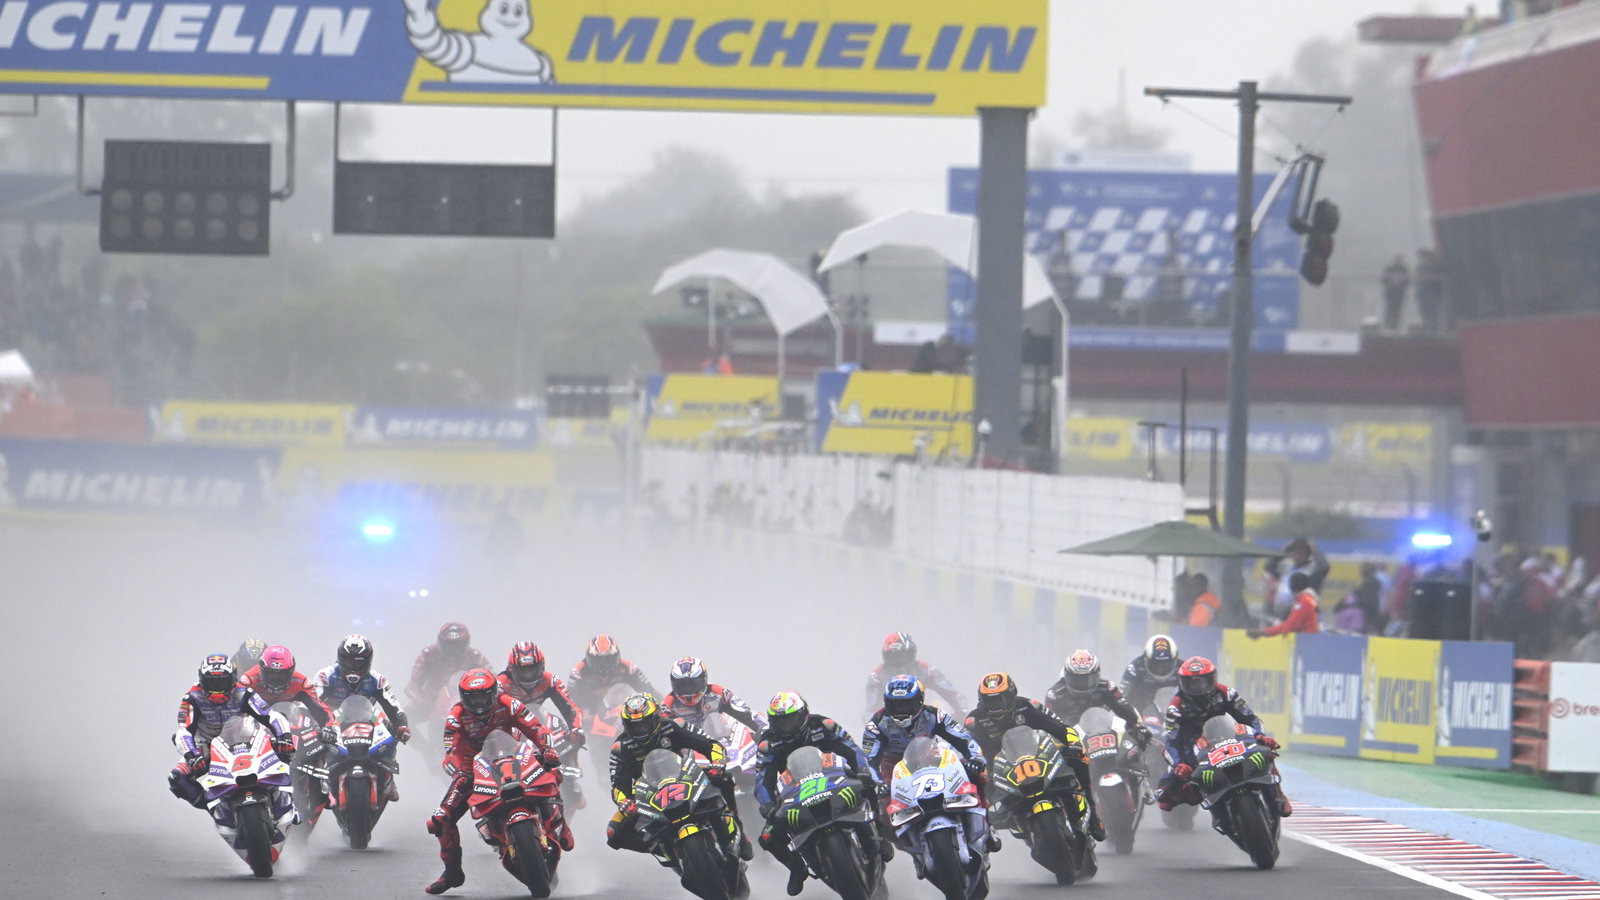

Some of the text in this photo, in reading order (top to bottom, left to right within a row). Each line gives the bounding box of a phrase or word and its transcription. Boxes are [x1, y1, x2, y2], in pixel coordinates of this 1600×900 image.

[566, 16, 1037, 73] MICHELIN
[195, 414, 335, 435] MICHELIN
[385, 418, 528, 439] MICHELIN
[24, 469, 245, 509] MICHELIN
[1304, 671, 1360, 720] MICHELIN
[1377, 676, 1433, 726] MICHELIN
[1451, 681, 1511, 730] MICHELIN
[341, 723, 373, 738] 42
[1087, 734, 1115, 753] 30
[1089, 748, 1118, 759] CUSTOM
[1214, 739, 1238, 749] ENEOS
[231, 755, 254, 772] 5
[260, 754, 279, 769] prima
[1014, 760, 1041, 783] 10
[522, 767, 544, 785] Lenovo
[800, 772, 825, 785] ENEOS
[473, 785, 498, 795] Lenovo
[655, 783, 686, 808] 72
[800, 777, 827, 801] 21
